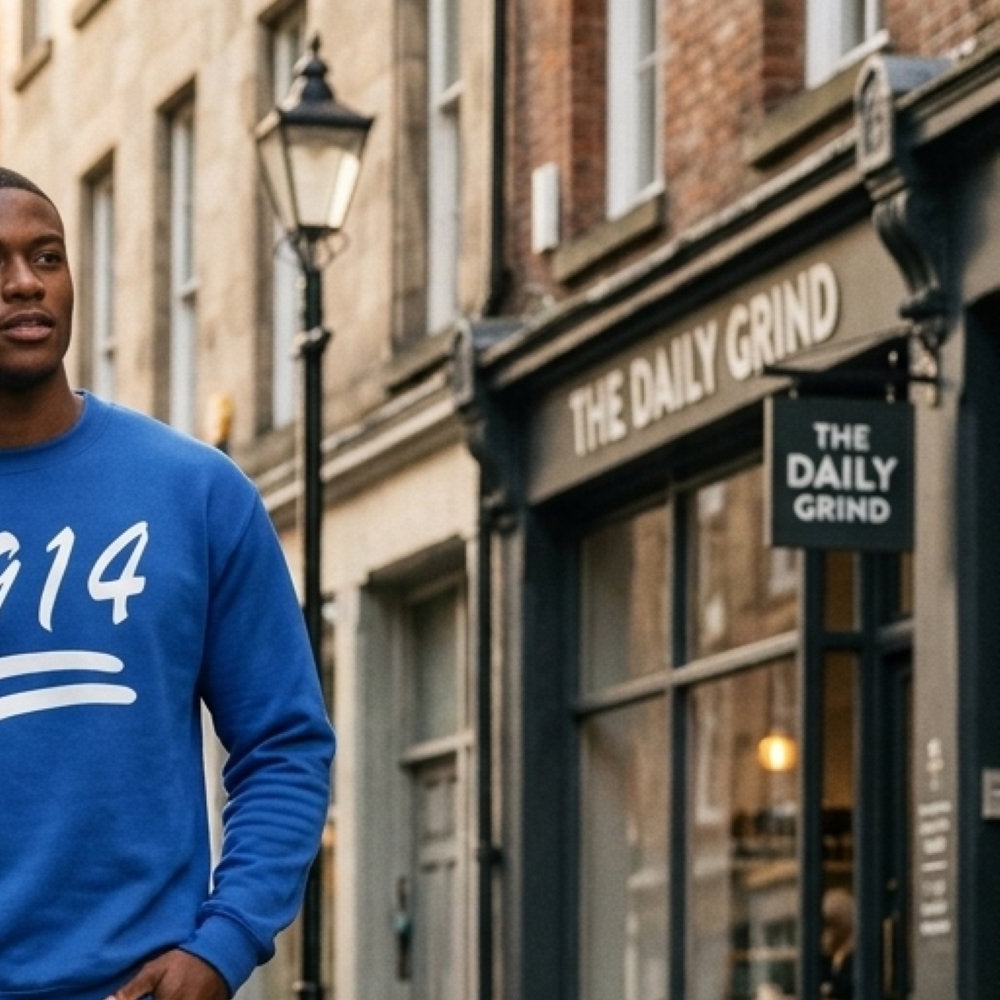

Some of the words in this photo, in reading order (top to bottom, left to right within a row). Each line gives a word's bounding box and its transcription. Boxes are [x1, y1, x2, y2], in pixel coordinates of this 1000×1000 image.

[569, 370, 627, 457] THE
[630, 321, 718, 429] DAILY
[725, 262, 839, 380] GRIND
[813, 422, 870, 451] THE
[786, 453, 898, 492] DAILY
[793, 494, 891, 524] GRIND
